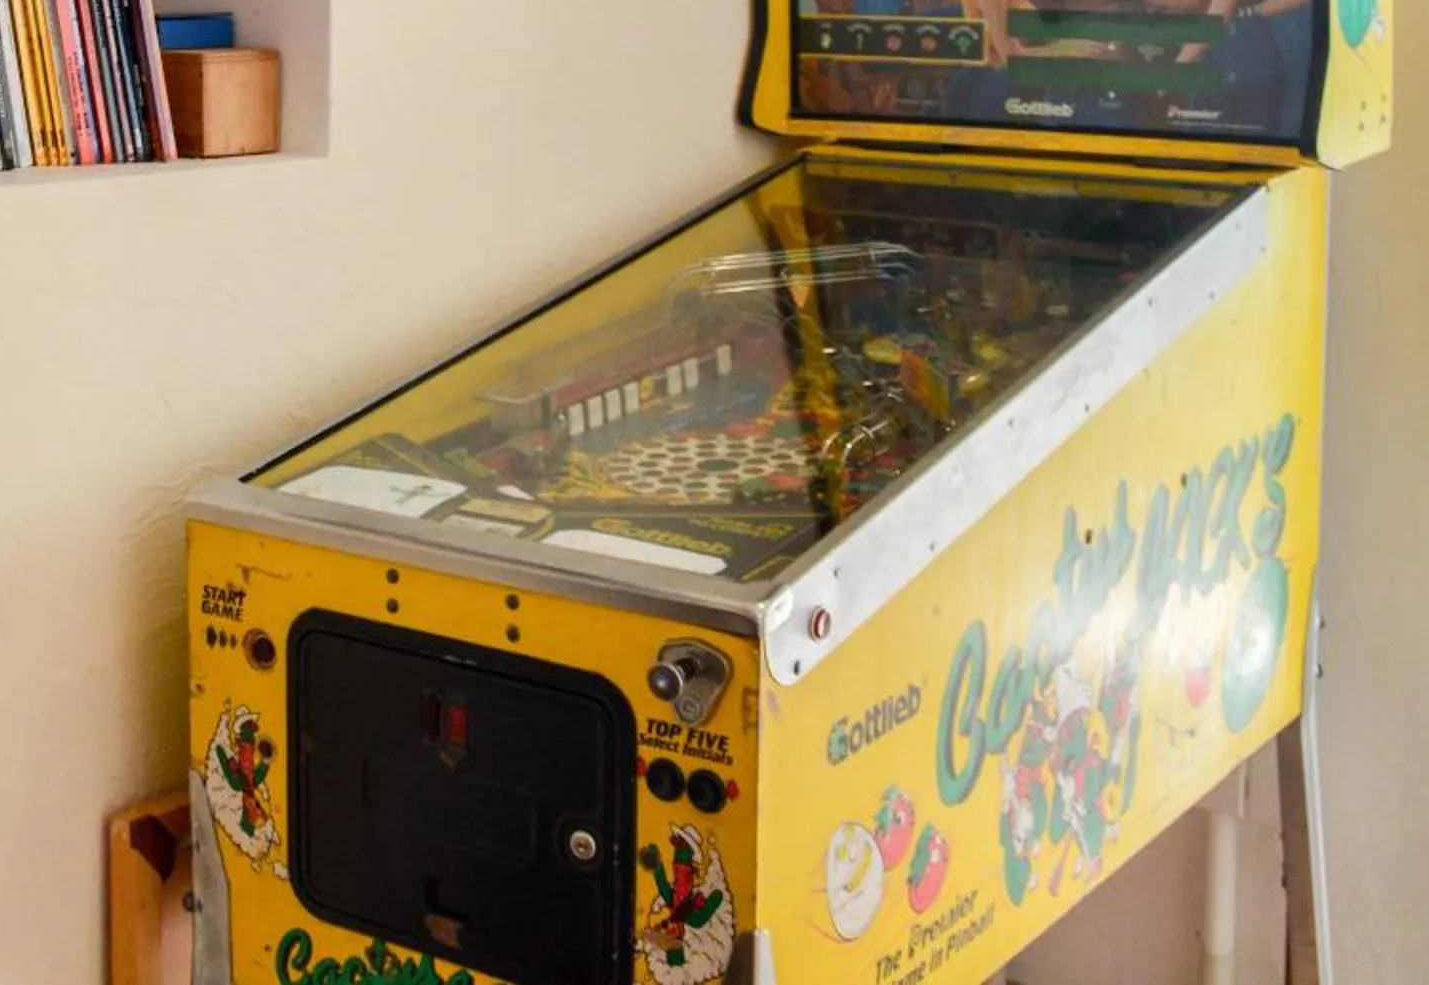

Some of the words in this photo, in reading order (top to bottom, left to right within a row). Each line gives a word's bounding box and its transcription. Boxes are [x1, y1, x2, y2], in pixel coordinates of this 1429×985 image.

[201, 599, 243, 622] GAME
[202, 584, 247, 607] START
[647, 718, 683, 738] TOP
[687, 727, 730, 753] FIVE
[826, 682, 922, 767] Gottlieb
[638, 732, 679, 753] Select
[682, 742, 734, 765] Initials
[875, 948, 903, 985] The
[908, 888, 978, 959] Premier
[945, 900, 996, 962] Pinball
